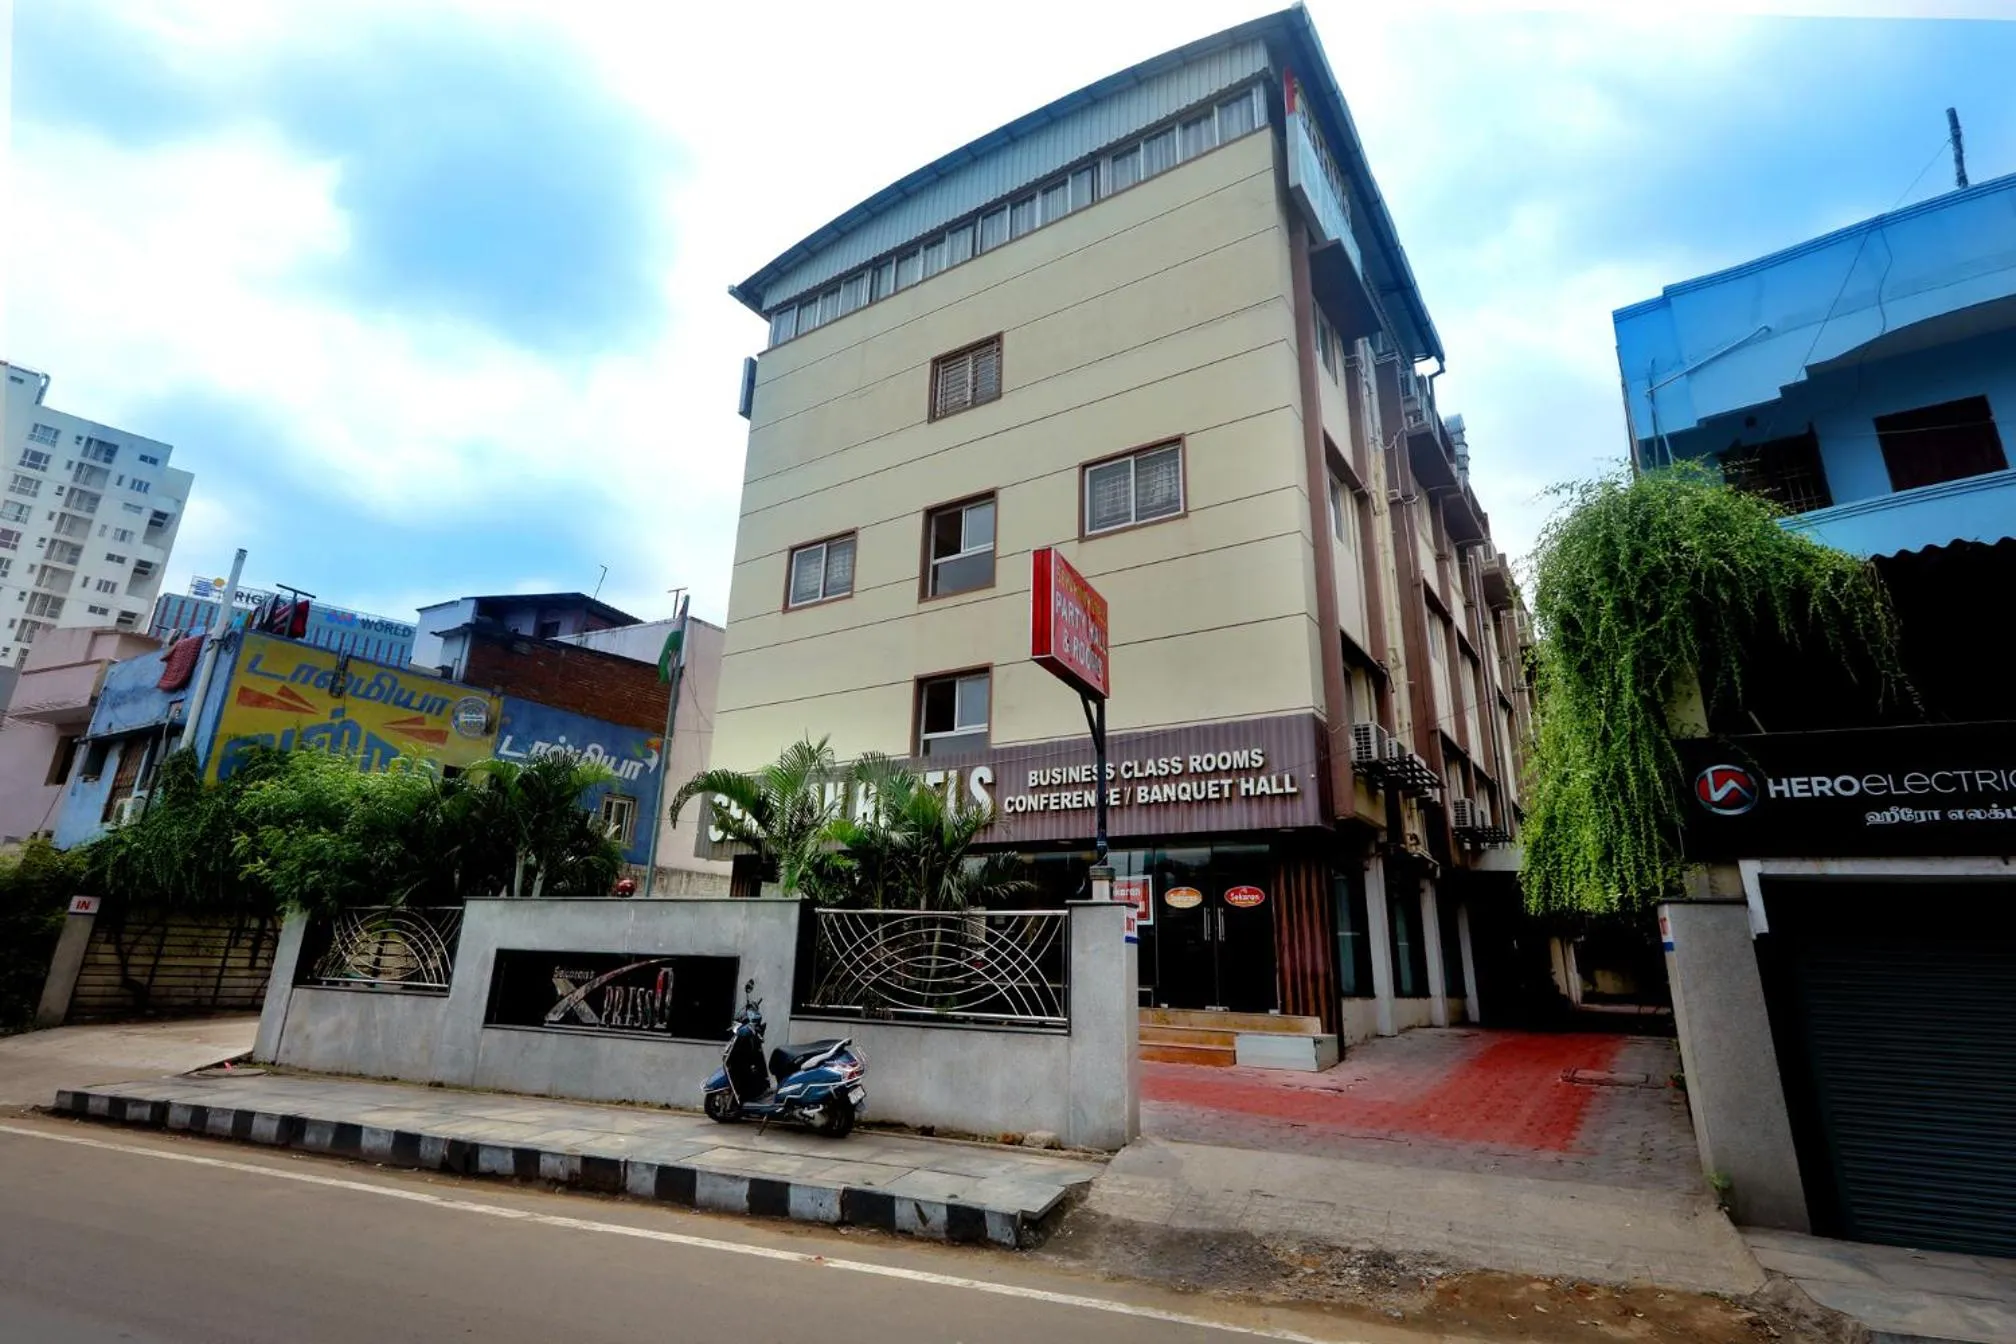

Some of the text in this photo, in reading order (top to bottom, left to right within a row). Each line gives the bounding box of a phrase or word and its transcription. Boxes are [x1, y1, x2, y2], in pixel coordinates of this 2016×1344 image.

[1028, 748, 1265, 788] BUSINESS CLASS ROOMS
[1004, 787, 1121, 813] CONFERENE
[1136, 779, 1233, 805] BANQUET
[1240, 773, 1298, 797] HALL
[76, 900, 91, 910] IN
